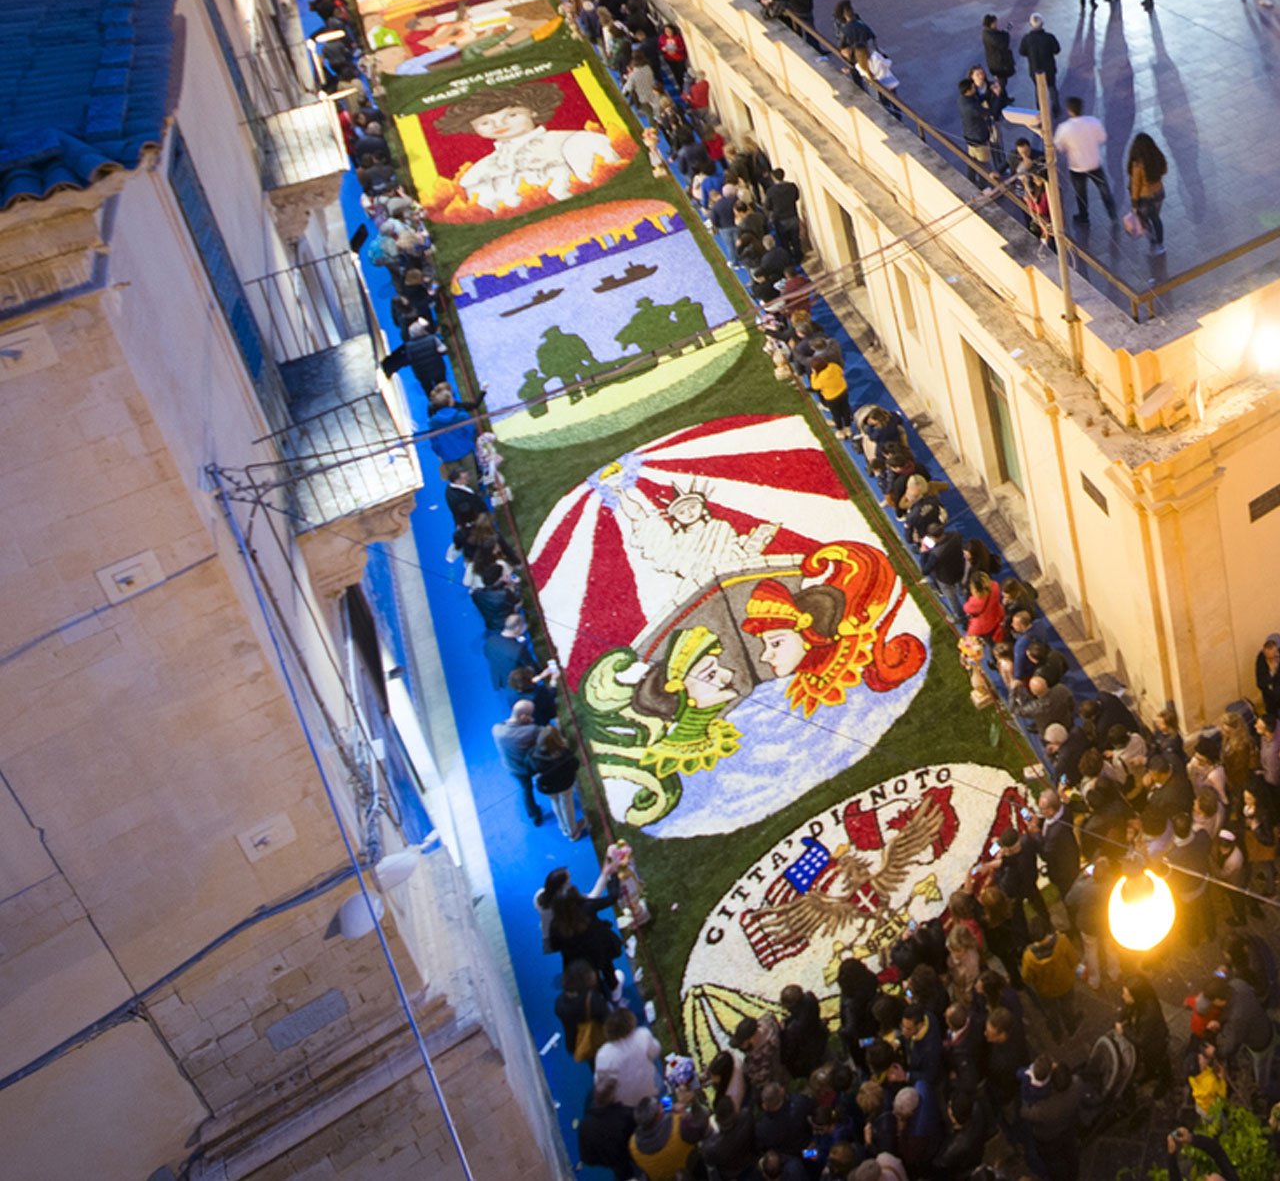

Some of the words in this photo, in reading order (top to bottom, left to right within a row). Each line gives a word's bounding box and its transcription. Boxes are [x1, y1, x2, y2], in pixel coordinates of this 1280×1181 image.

[485, 61, 553, 86] COMPANY
[808, 807, 845, 840] DI
[869, 767, 952, 806] NOTO
